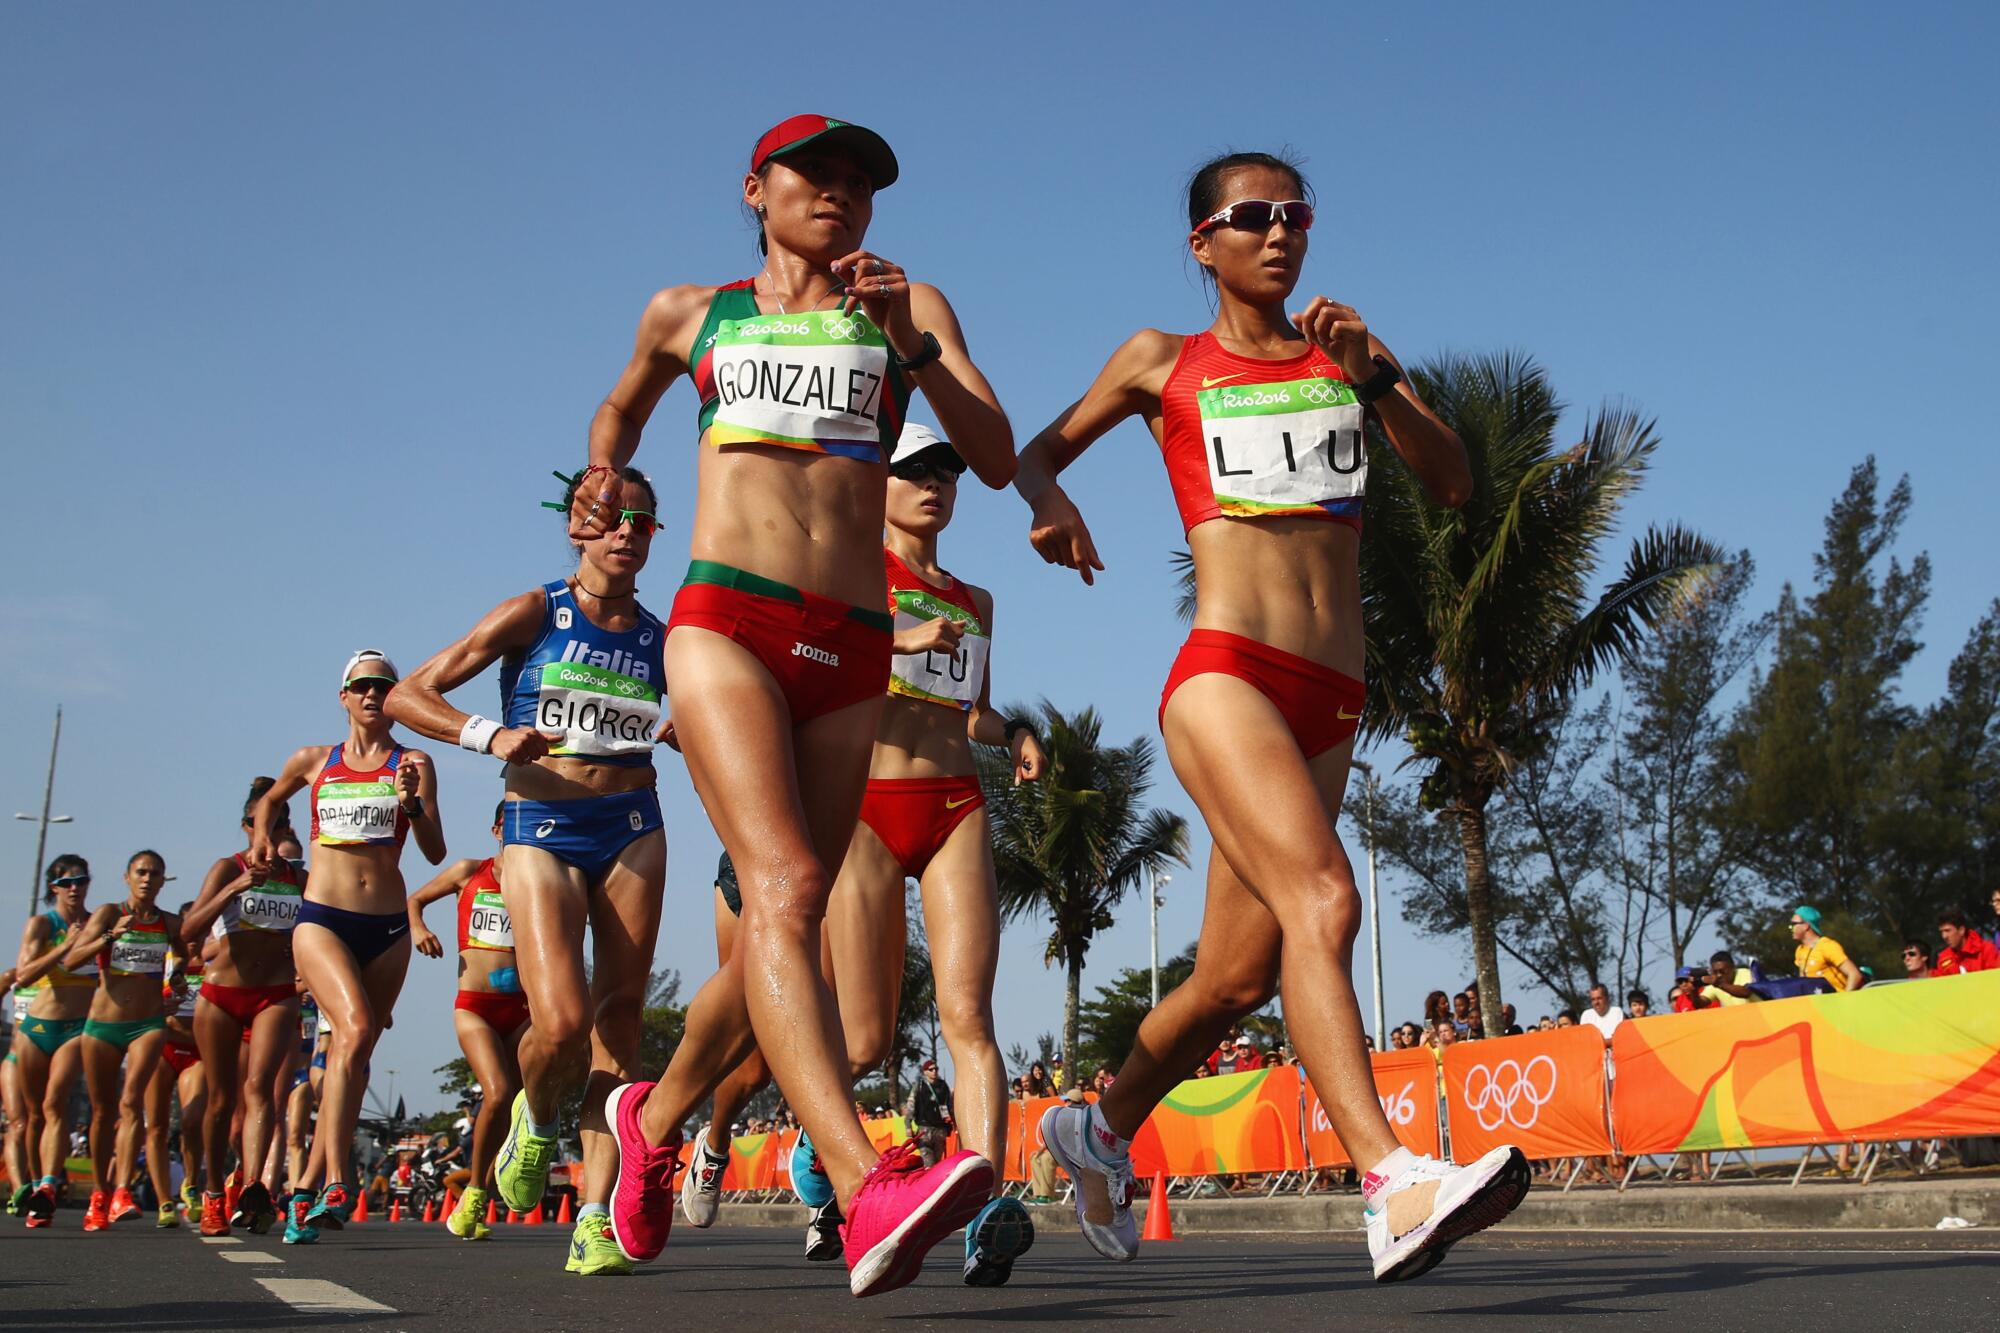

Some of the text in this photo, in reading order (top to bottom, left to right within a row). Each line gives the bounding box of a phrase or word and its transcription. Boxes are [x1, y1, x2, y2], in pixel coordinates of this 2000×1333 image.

[718, 358, 881, 421] GONZALEZ
[1213, 430, 1361, 477] LIU
[560, 639, 650, 683] Italia
[925, 649, 967, 682] LU
[243, 897, 300, 920] GARCIA
